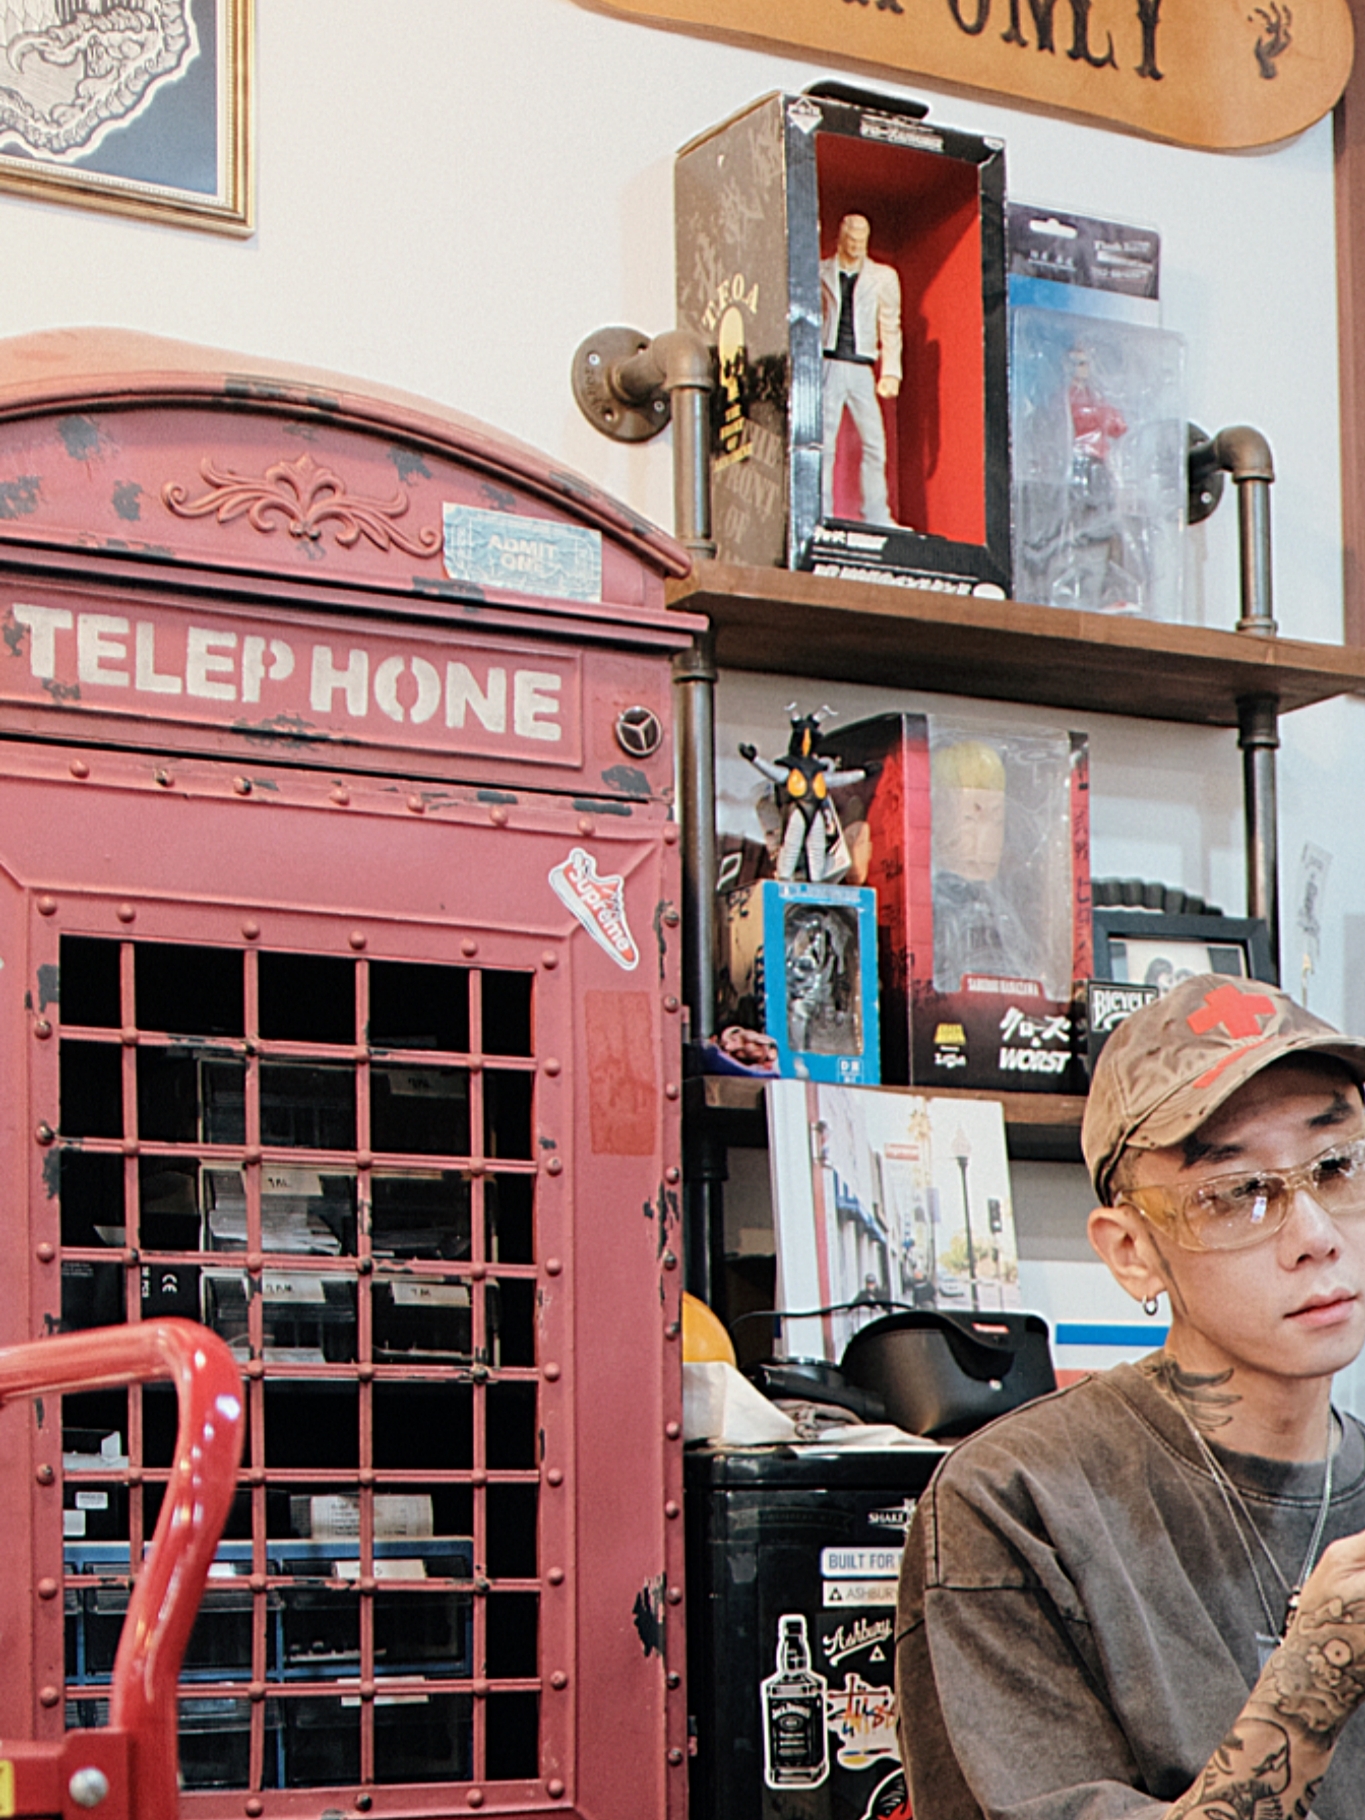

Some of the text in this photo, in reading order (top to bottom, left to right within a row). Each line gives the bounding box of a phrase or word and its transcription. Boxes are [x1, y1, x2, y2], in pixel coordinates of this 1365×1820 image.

[488, 534, 558, 560] ADMIT
[501, 552, 544, 573] ONE
[568, 863, 629, 952] Supreme
[1000, 1006, 1072, 1042] クローズ
[999, 1047, 1072, 1073] WORST
[828, 1553, 895, 1569] BUILT FOR
[822, 1617, 893, 1657] Ashbury
